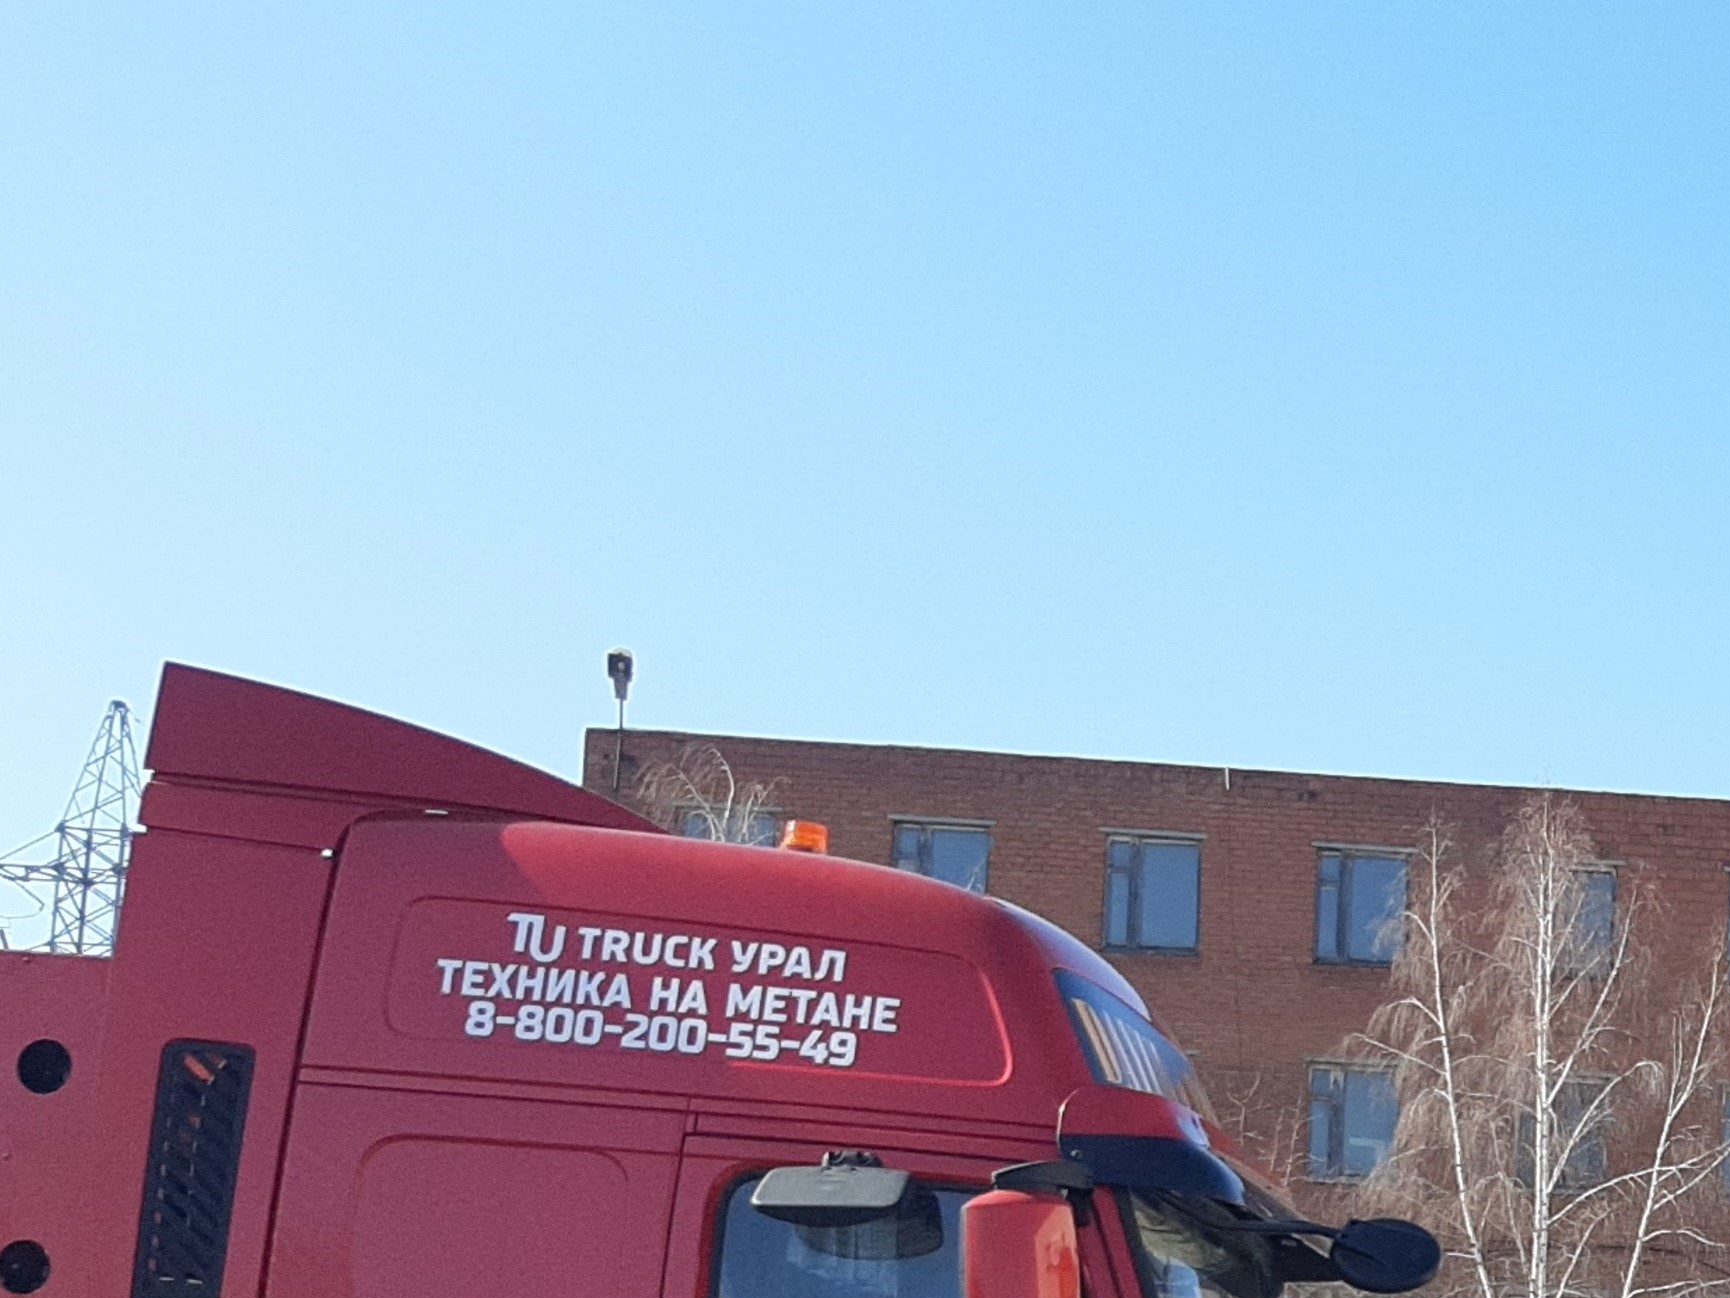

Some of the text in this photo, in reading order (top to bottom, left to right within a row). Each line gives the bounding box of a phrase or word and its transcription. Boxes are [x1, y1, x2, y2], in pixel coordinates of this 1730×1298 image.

[577, 927, 717, 969] TRUCK
[731, 940, 846, 982] УРАЛ
[437, 958, 901, 1033] ТЕХНИКА НА МЕТАНЕ
[464, 1001, 857, 1066] 8-800-200-55-49
